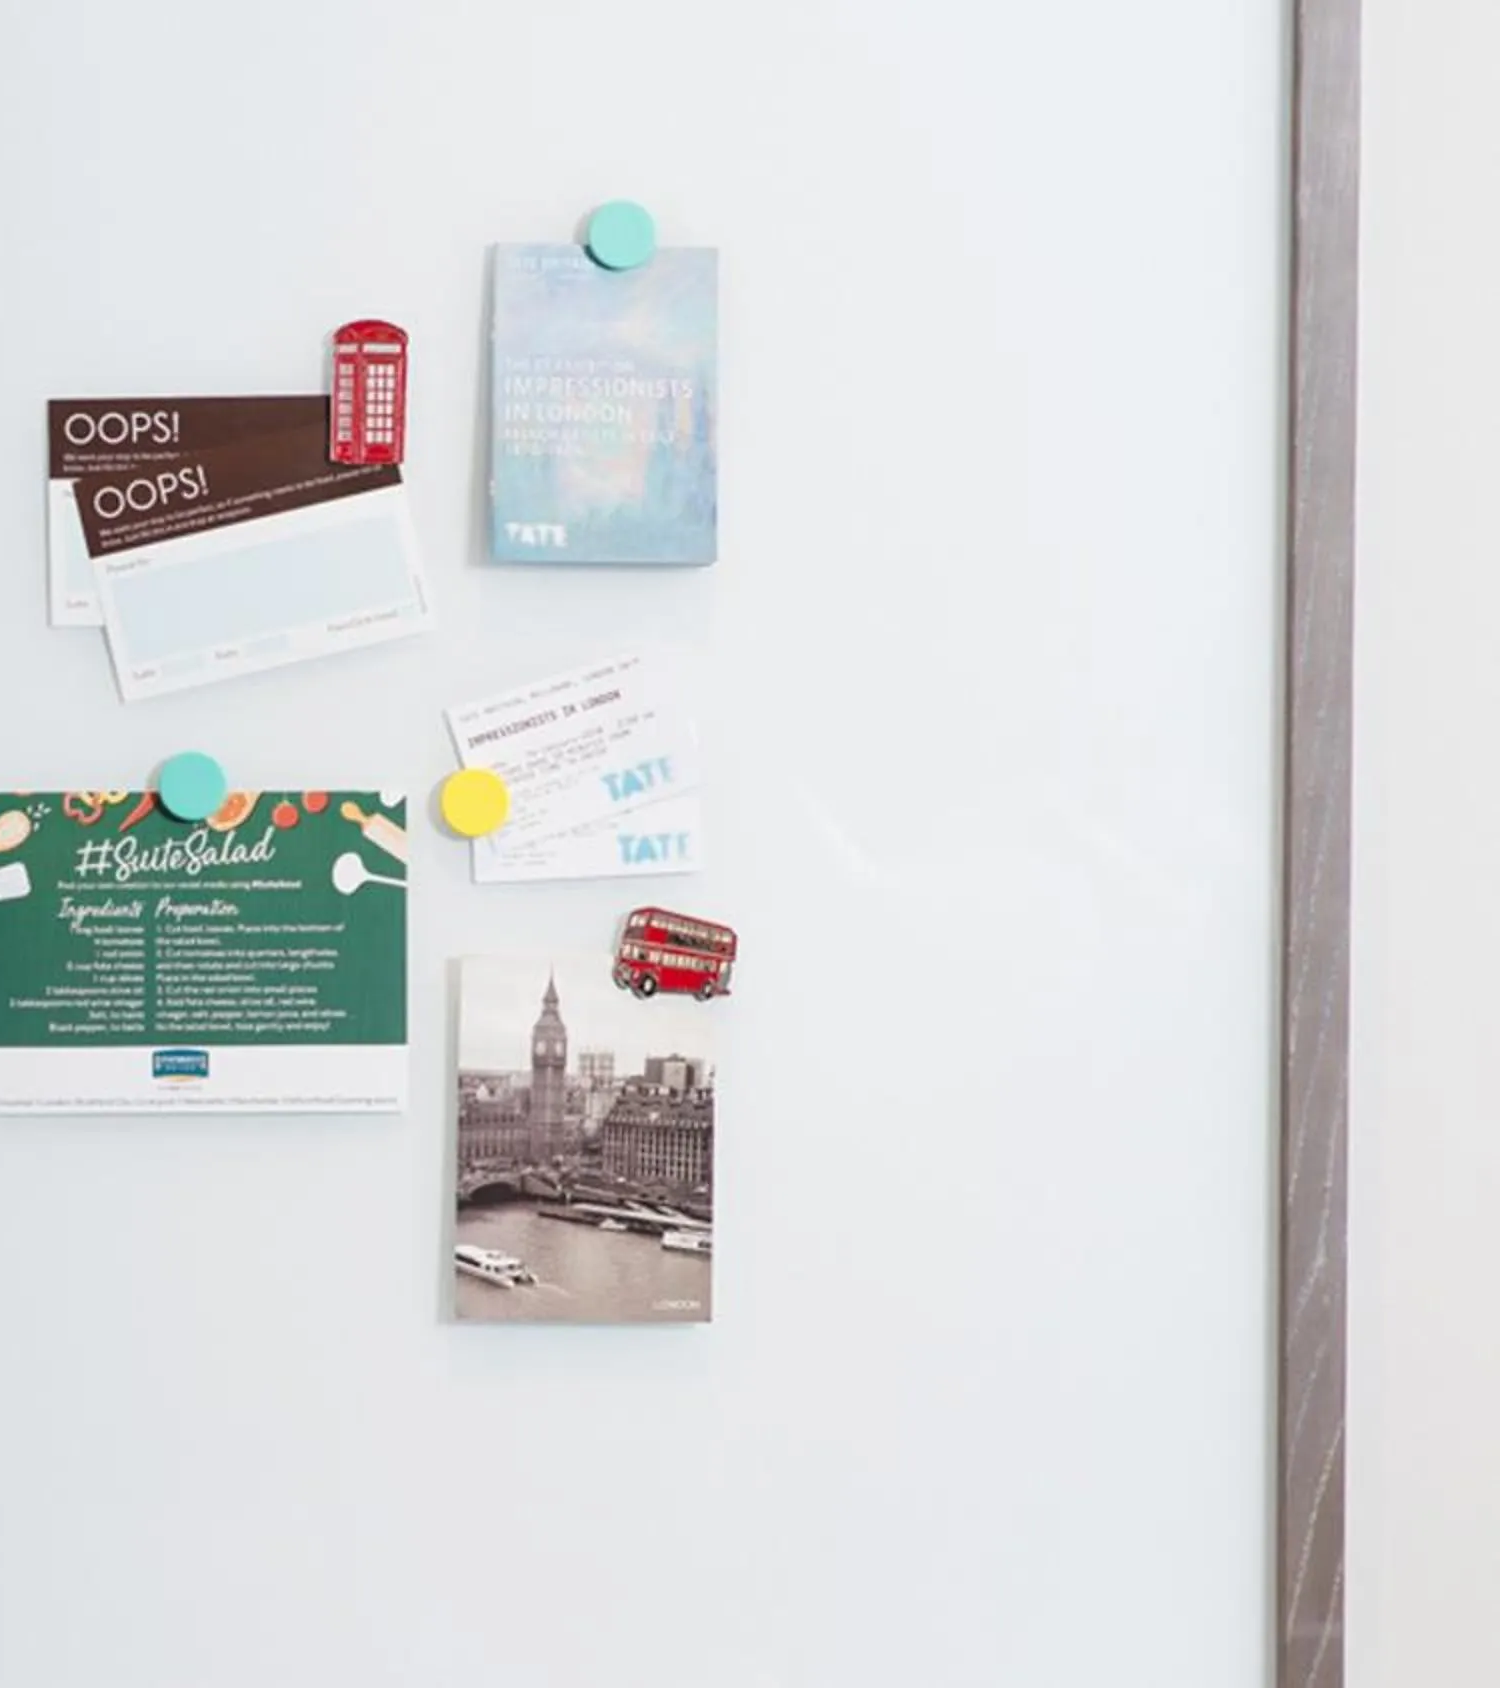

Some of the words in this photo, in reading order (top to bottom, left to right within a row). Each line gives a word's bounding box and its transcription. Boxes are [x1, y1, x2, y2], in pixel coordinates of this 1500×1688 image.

[504, 376, 693, 399] IMPRESSIONISTS
[64, 411, 180, 445] OOPS!
[505, 402, 531, 421] IN
[535, 402, 632, 423] LONDON
[93, 464, 209, 519] OOPS!
[504, 522, 568, 548] TATE
[467, 709, 558, 749] IMPRESSIONISTS
[562, 703, 579, 718] IN
[581, 689, 622, 712] LONDON
[600, 754, 674, 801] TATE
[75, 825, 276, 881] #SuiteSalad
[617, 831, 692, 865] TATE
[57, 896, 144, 927] Ingredients
[155, 895, 240, 921] Preparation
